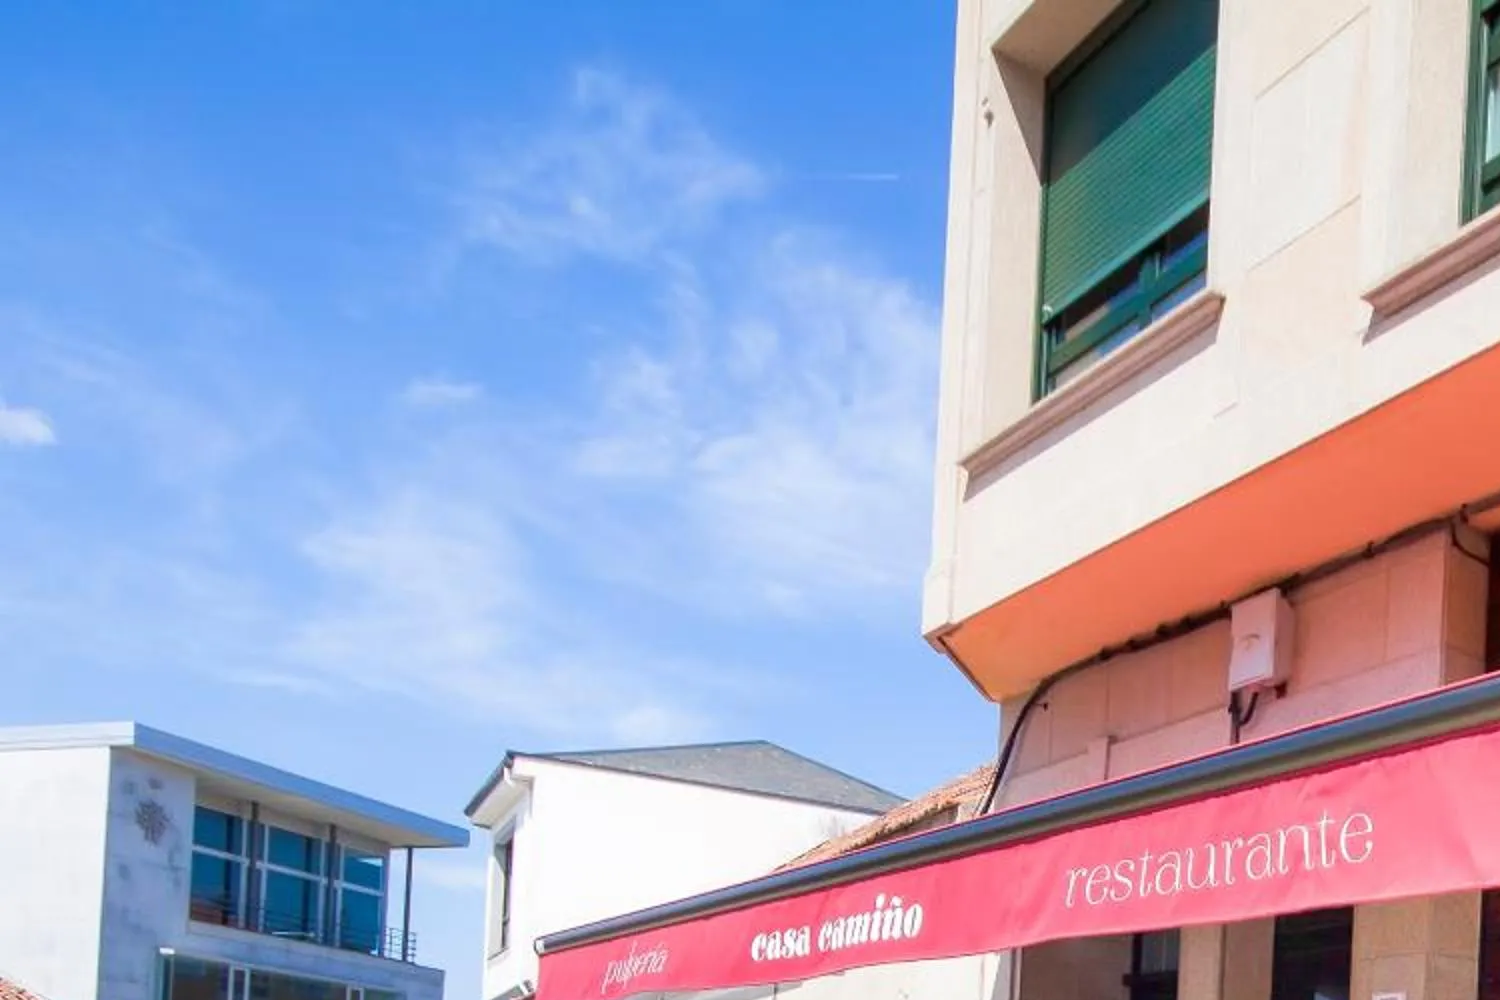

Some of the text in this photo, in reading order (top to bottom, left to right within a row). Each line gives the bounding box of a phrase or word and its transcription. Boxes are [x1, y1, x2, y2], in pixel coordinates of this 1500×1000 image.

[1064, 809, 1375, 909] restaurante
[751, 893, 924, 961] casa camiño
